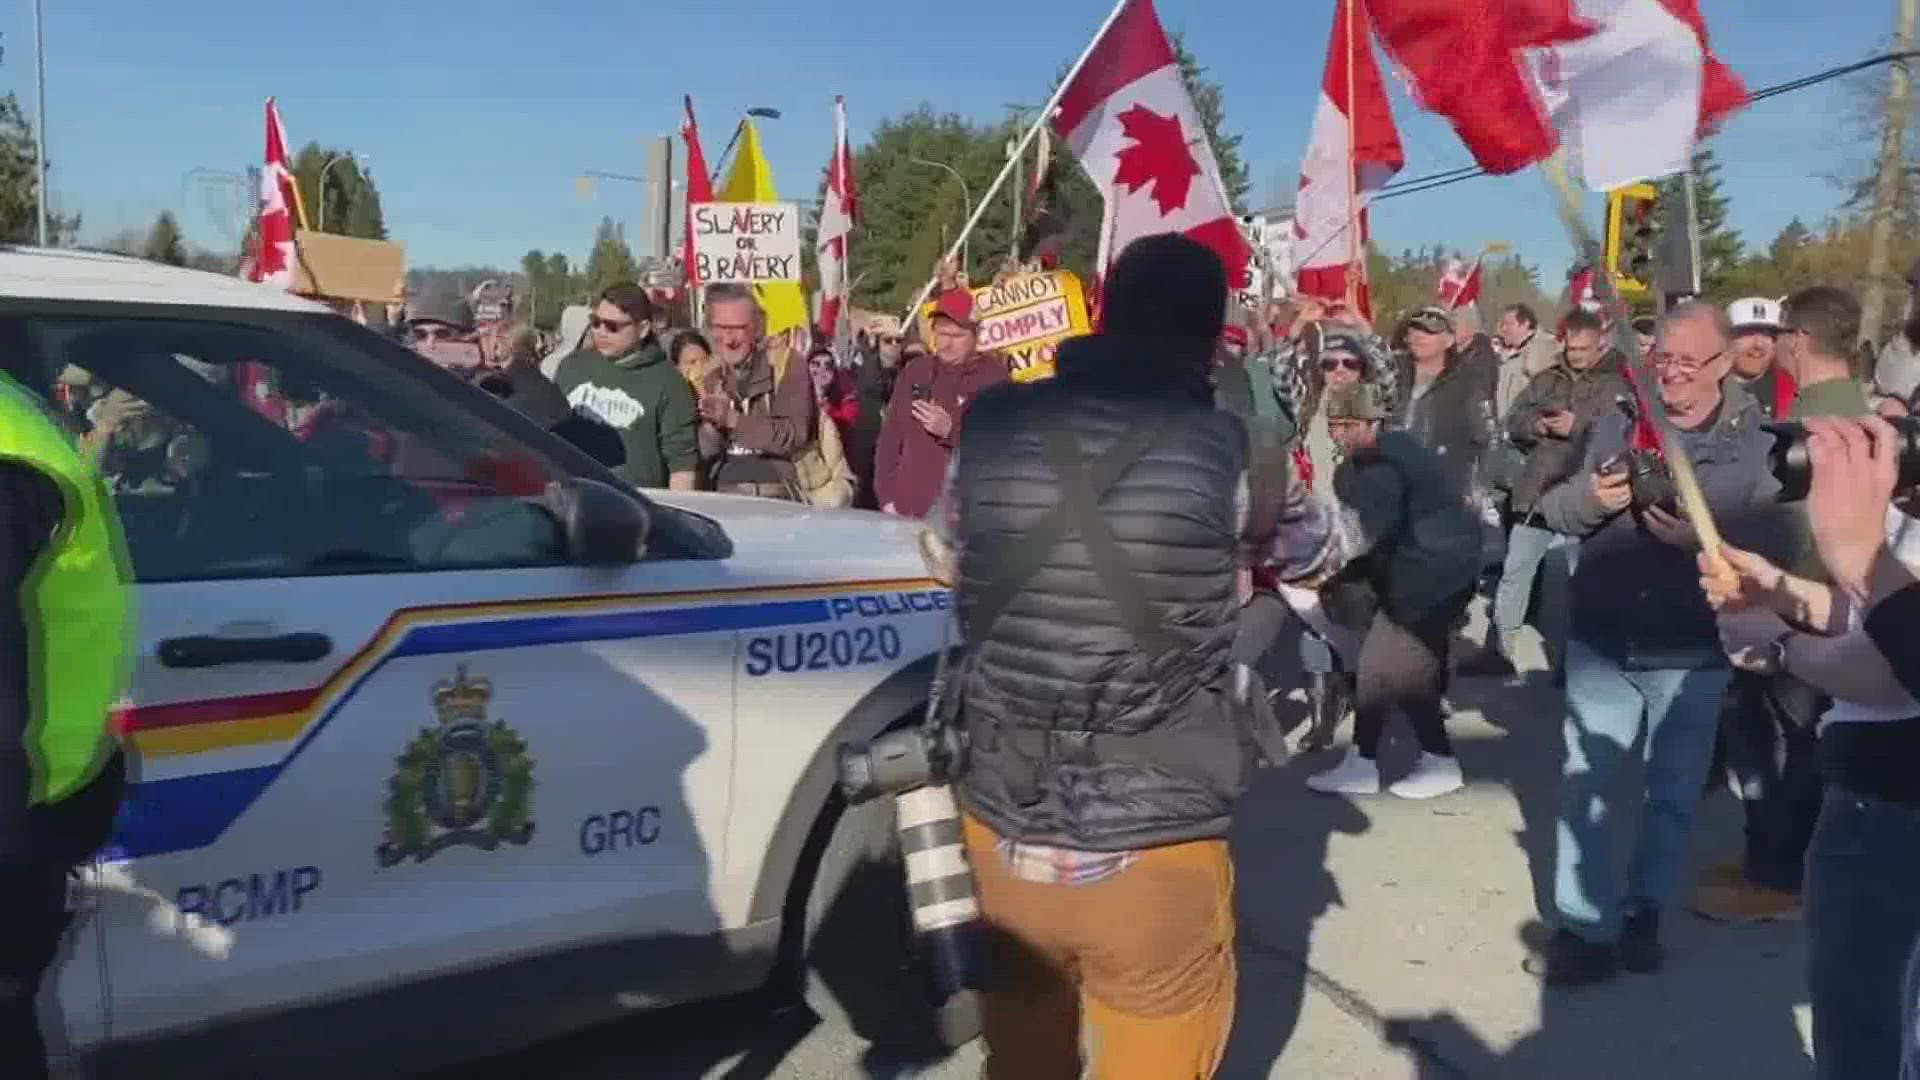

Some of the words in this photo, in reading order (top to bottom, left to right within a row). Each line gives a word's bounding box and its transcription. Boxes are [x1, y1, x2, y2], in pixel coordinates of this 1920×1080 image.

[696, 207, 785, 235] SLAVERY
[735, 236, 757, 250] OR
[696, 252, 793, 281] BRAVERY
[975, 274, 1058, 314] CANNOT
[975, 303, 1065, 346] COMPLY
[831, 590, 949, 621] POLICE
[746, 623, 901, 677] SU2020
[580, 805, 661, 856] GRC
[175, 865, 322, 926] RCMP
